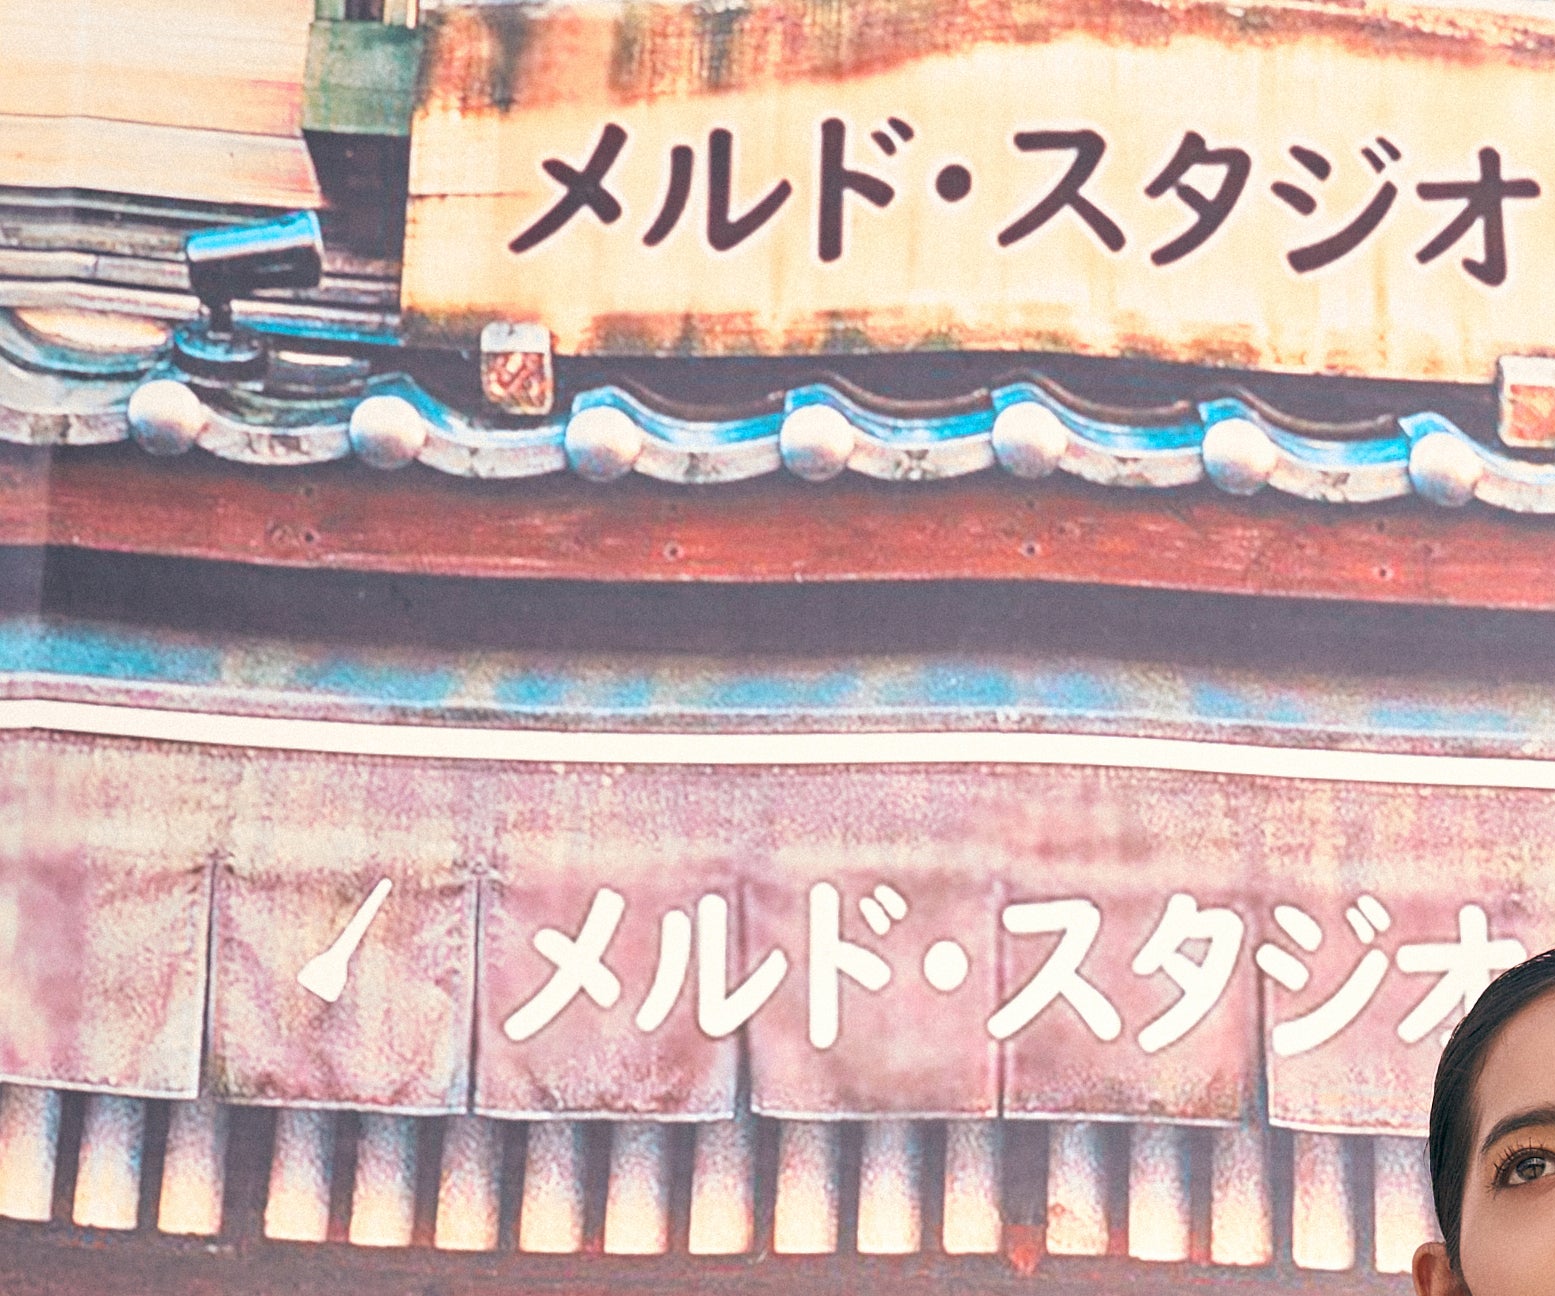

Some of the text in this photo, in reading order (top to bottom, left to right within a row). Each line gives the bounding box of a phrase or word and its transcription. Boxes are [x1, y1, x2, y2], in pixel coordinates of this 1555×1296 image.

[509, 117, 1541, 287] メルド・スタジオ
[503, 881, 1527, 1056] メルド・スタジオ
